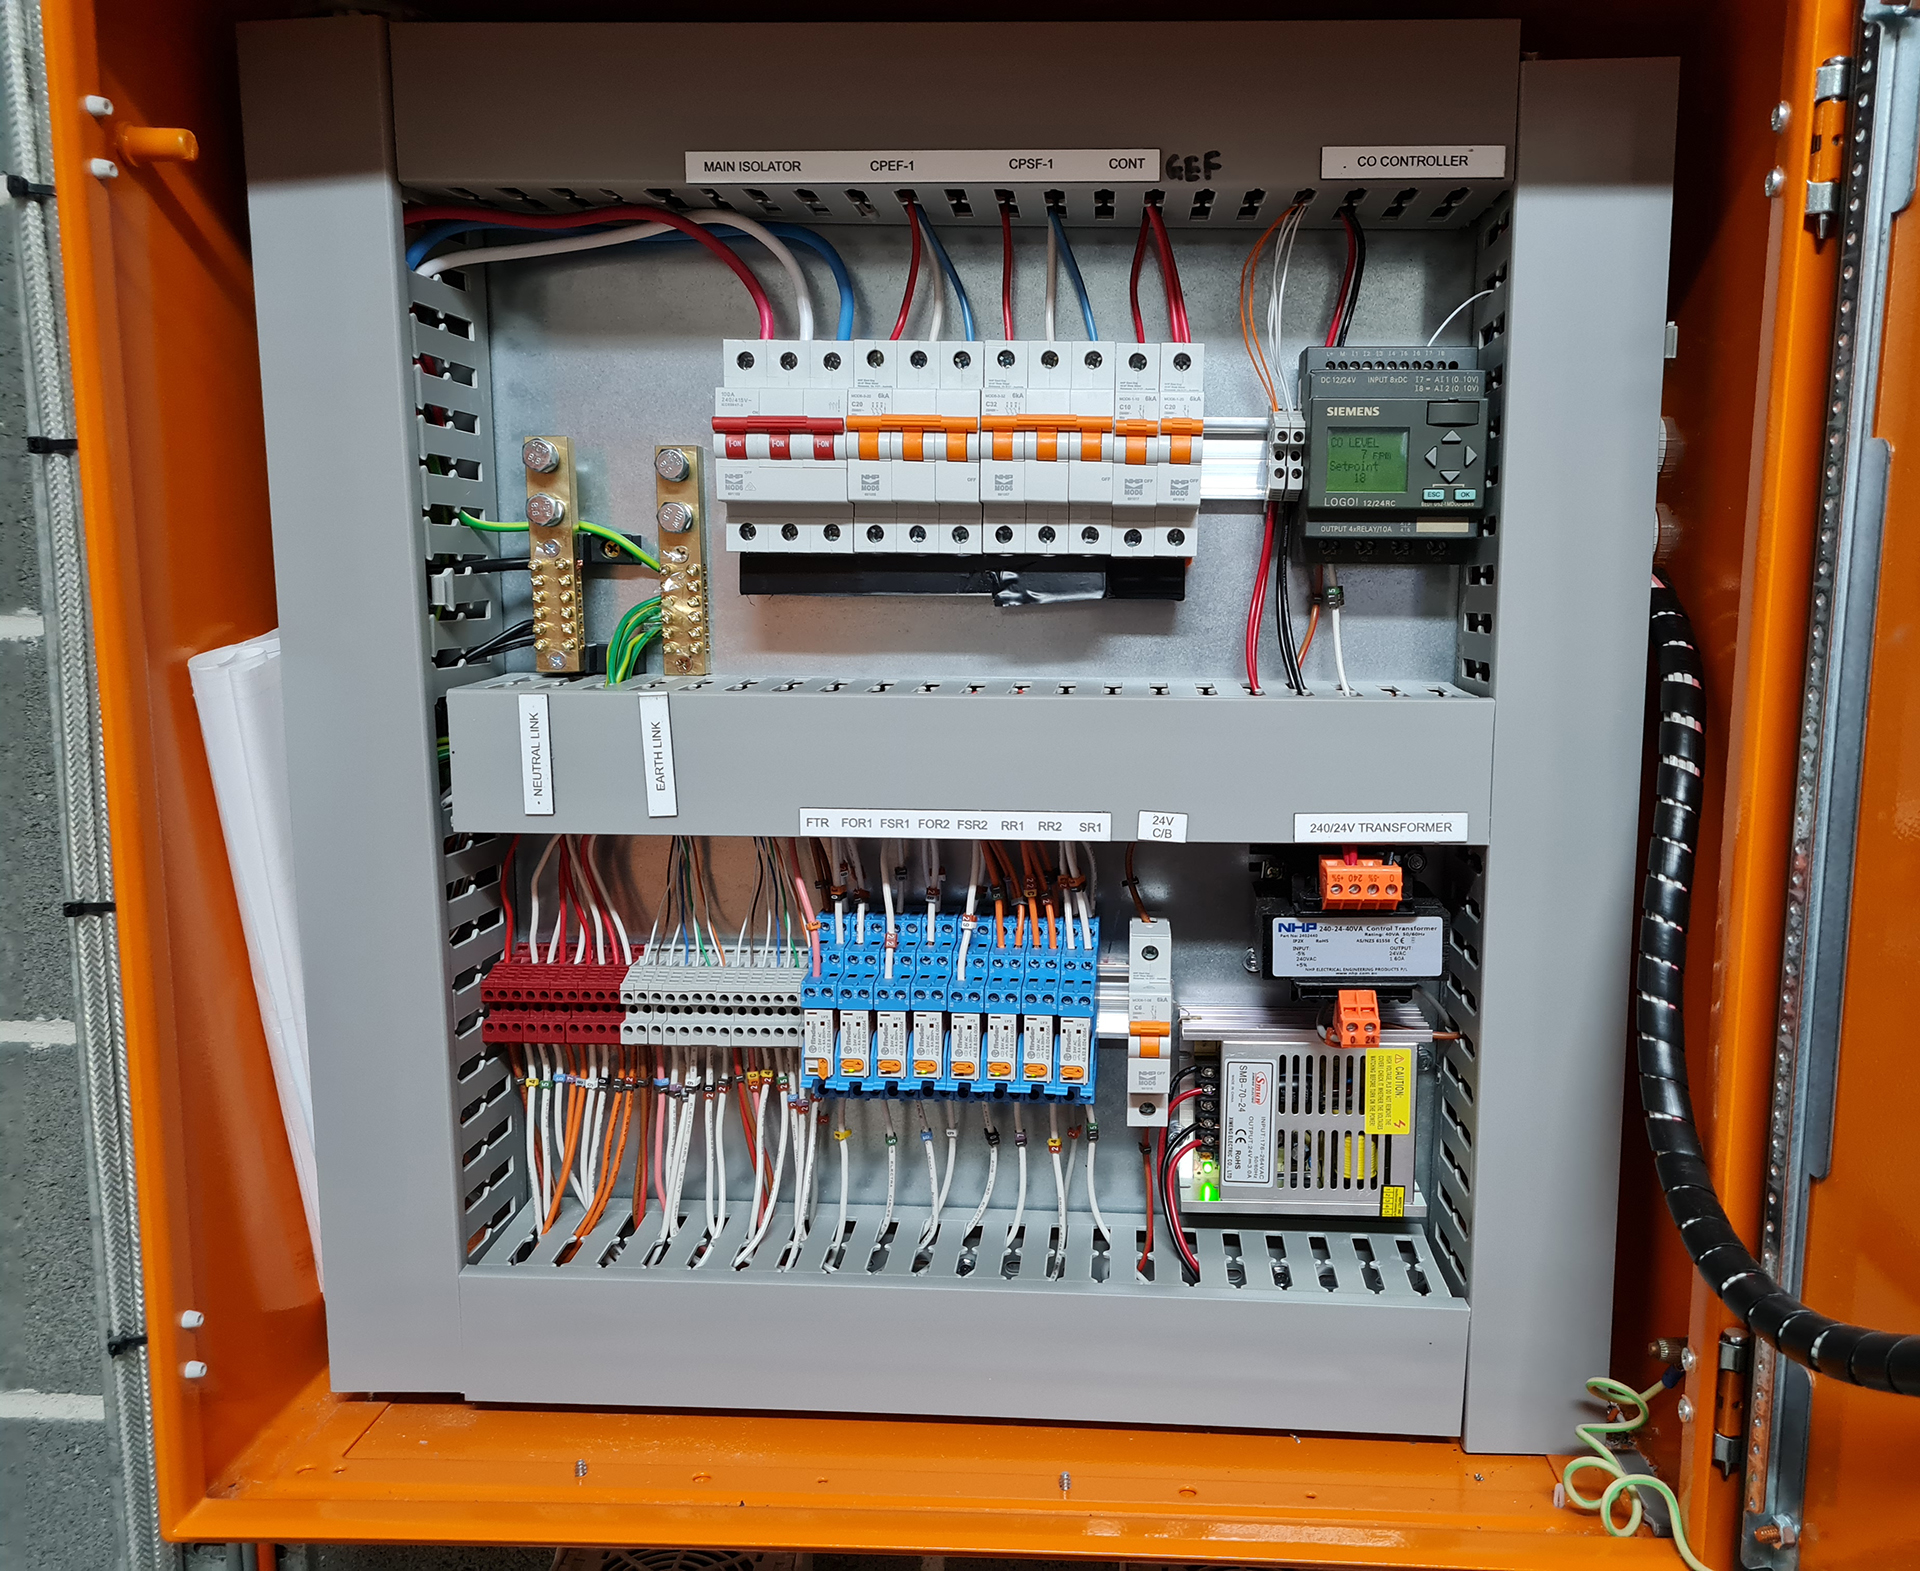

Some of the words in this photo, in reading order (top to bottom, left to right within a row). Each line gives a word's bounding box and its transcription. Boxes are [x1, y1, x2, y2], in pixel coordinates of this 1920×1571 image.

[704, 161, 735, 172] MAIN
[739, 160, 802, 172] ISOLATOR
[870, 160, 914, 172] CPEF-1
[1009, 158, 1054, 170] CPSF-1
[1108, 158, 1146, 170] CONT
[1166, 150, 1222, 182] GEF
[1357, 156, 1376, 167] CO
[1380, 155, 1468, 167] CONTROLLER
[1326, 406, 1380, 416] SIEMENS
[1331, 438, 1343, 447] CO
[1350, 438, 1380, 448] LEVEL
[1362, 449, 1368, 460] 7
[1330, 461, 1379, 472] Setpoint
[1354, 473, 1366, 483] 18
[1324, 498, 1359, 507] LOGO!
[528, 712, 540, 738] LINK
[650, 721, 662, 748] LINK
[530, 744, 543, 796] NEUTRAL
[654, 751, 666, 792] EARTH
[806, 818, 830, 828] FTR
[842, 818, 872, 828] FOR1
[880, 818, 910, 829] FSR1
[918, 818, 950, 830] FOR2
[957, 820, 988, 830] FSR2
[1001, 821, 1024, 831] RR1
[1038, 821, 1062, 832] RR2
[1152, 816, 1174, 826] 24V
[1079, 822, 1102, 833] SR1
[1310, 823, 1356, 834] 240/24V
[1358, 822, 1452, 833] TRANSFORMER
[1152, 828, 1173, 839] C/B
[1348, 874, 1362, 882] 240
[1278, 922, 1317, 932] NHP
[1350, 1036, 1356, 1044] 0
[1365, 1036, 1376, 1044] 24
[1238, 1065, 1248, 1112] SMB-70-24
[1255, 1076, 1265, 1105] Smun
